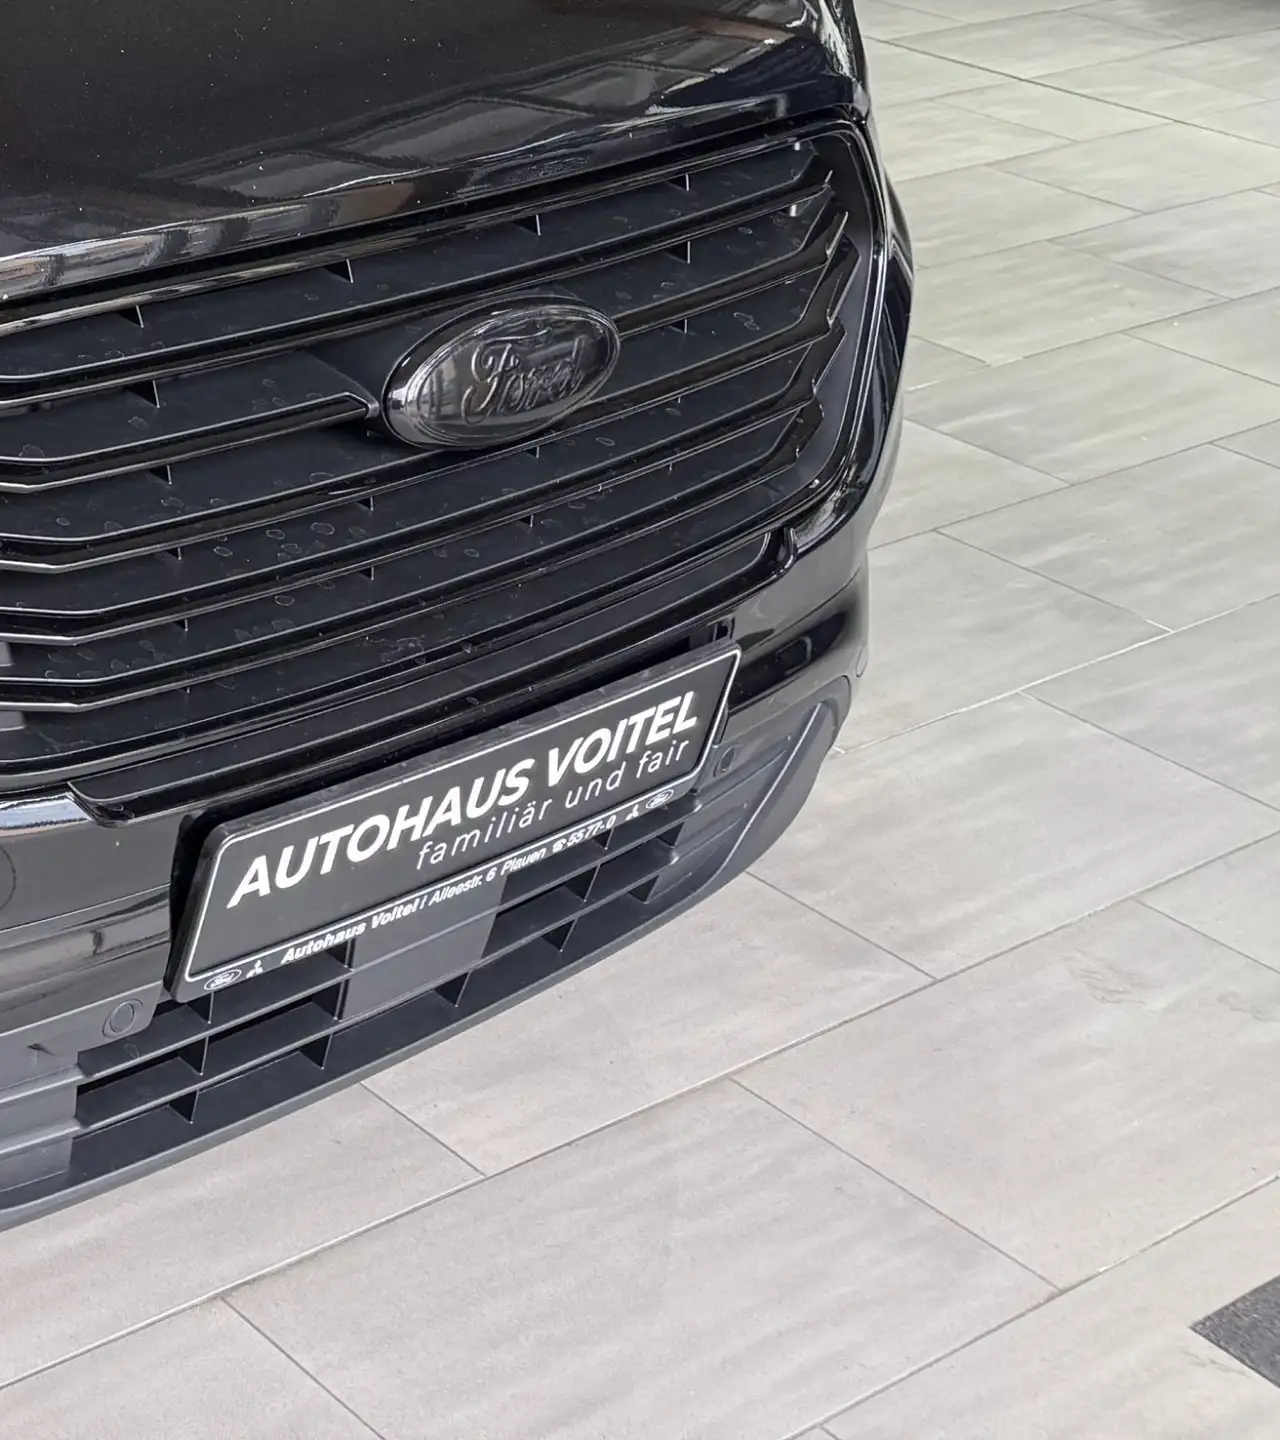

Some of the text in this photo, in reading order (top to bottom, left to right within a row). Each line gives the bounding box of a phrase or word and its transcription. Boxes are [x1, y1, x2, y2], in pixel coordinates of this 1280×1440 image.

[462, 327, 586, 424] Ford
[226, 690, 698, 909] AUTOHAUS VOITEL
[416, 737, 690, 869] familiär und fair
[281, 921, 367, 965] Autohaus
[371, 898, 420, 930] Voitel
[428, 878, 483, 907] Alleestr.
[486, 866, 497, 882] 6
[501, 846, 547, 876] Plauen
